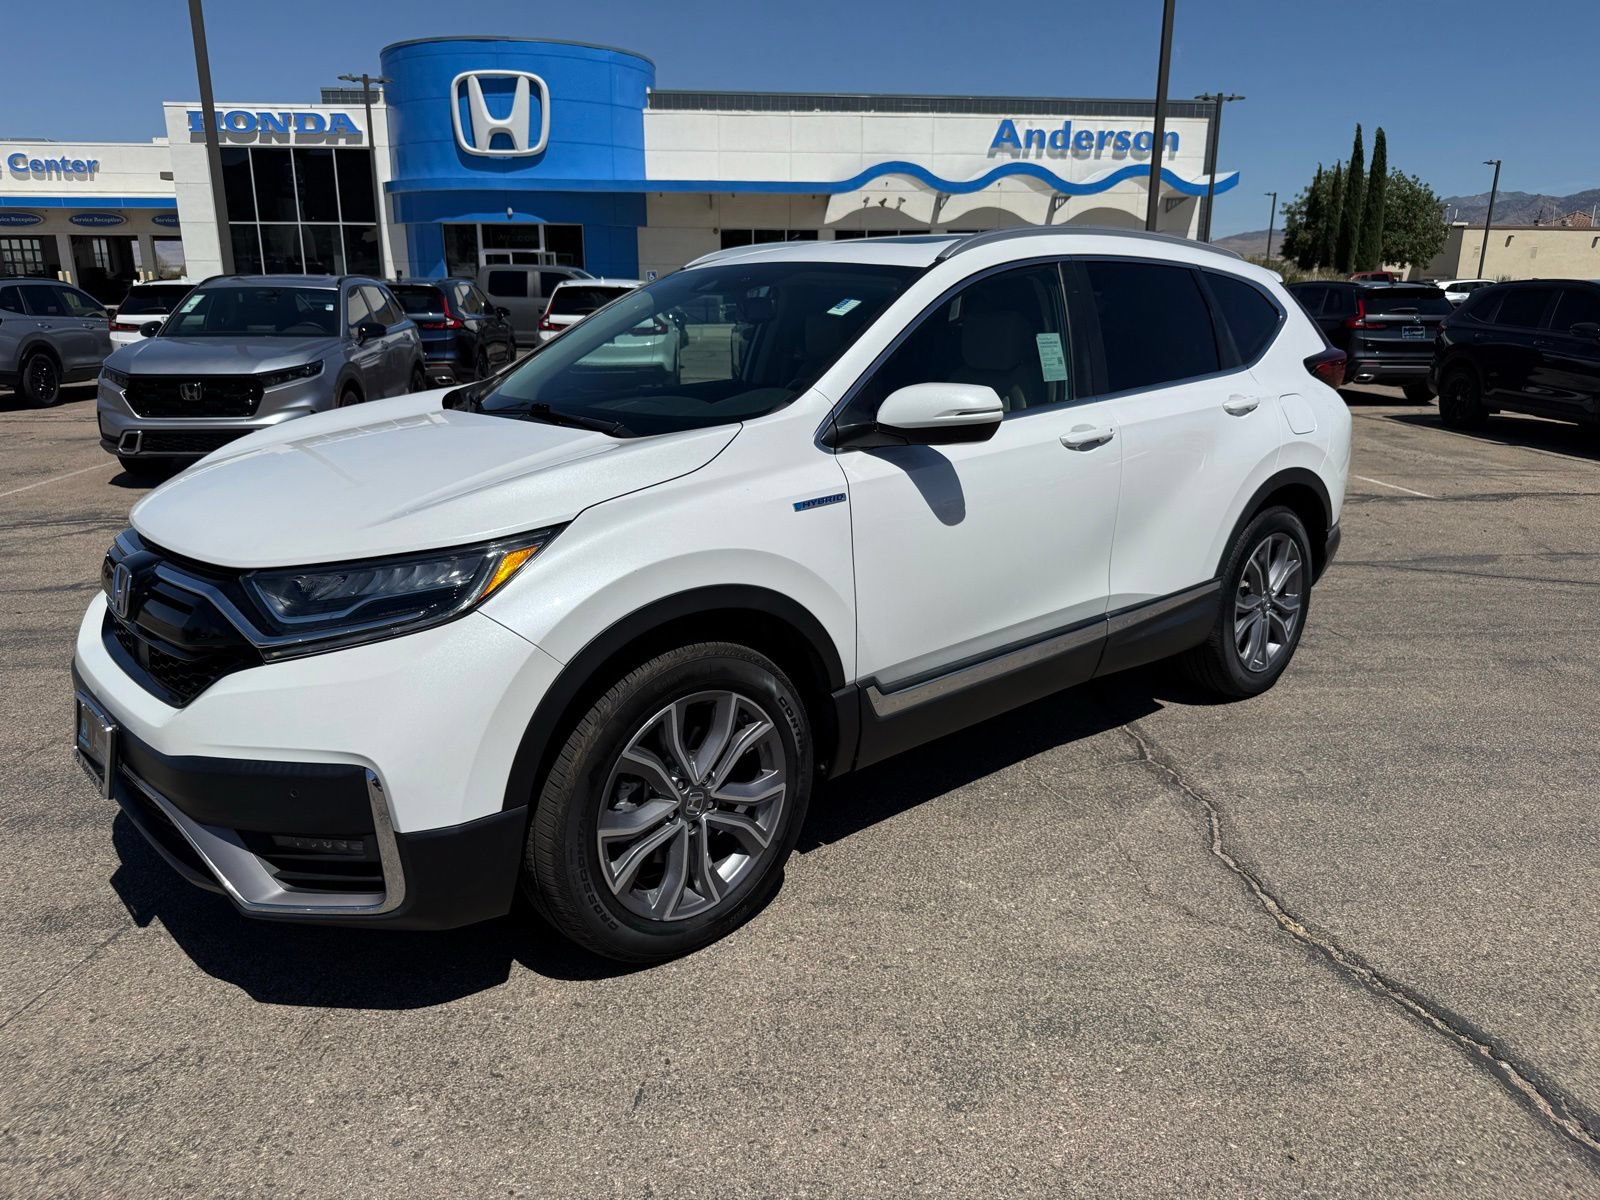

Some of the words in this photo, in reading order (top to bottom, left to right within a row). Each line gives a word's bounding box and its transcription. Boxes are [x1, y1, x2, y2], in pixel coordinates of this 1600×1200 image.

[186, 110, 363, 135] HONDA
[990, 119, 1180, 152] Anderson
[7, 152, 98, 174] Center
[802, 494, 845, 509] HYBRID
